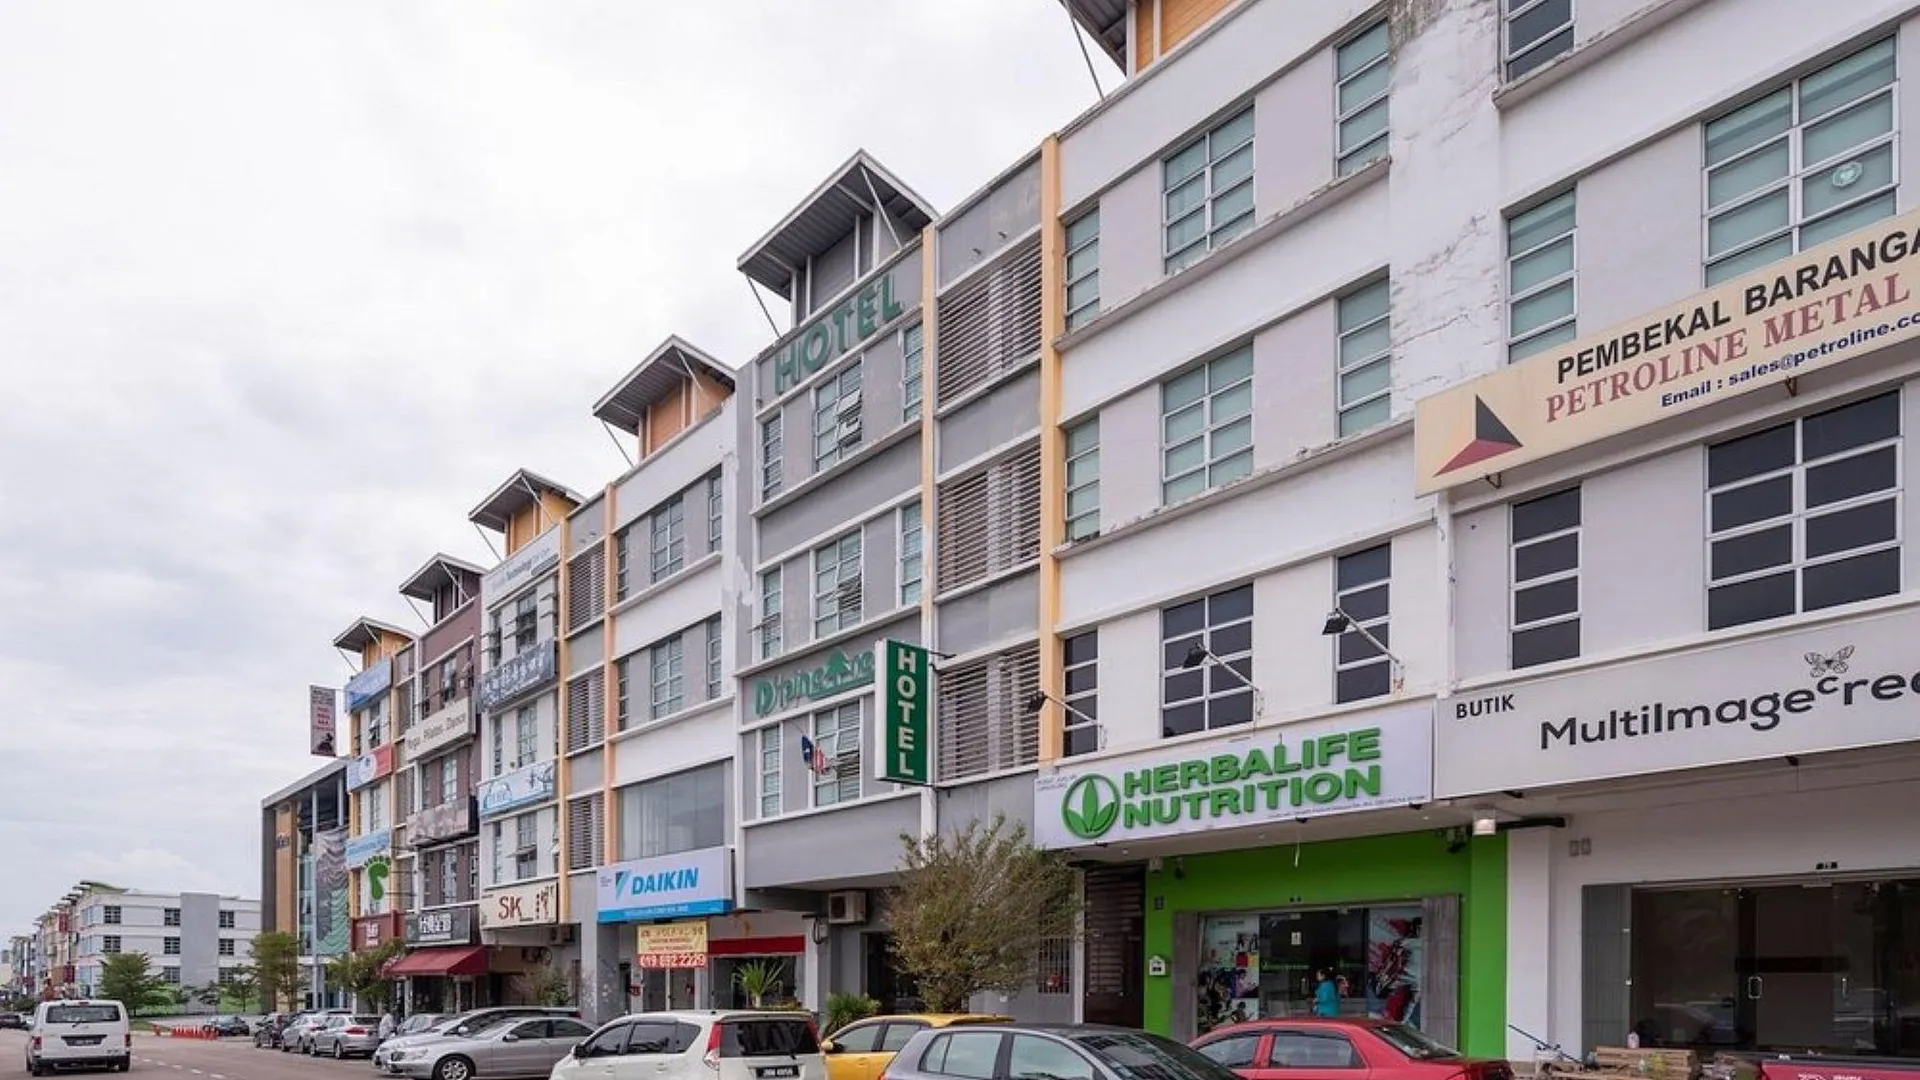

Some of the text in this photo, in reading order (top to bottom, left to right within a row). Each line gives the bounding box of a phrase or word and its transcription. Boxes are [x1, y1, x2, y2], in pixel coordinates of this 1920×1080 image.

[774, 272, 902, 395] HOTEL
[1546, 273, 1911, 422] PETROLINE METAL
[1557, 300, 1731, 384] PEMBEKAL
[1661, 379, 1711, 408] Email
[897, 648, 917, 776] HOTEL
[1456, 694, 1515, 719] BUTIK
[1124, 727, 1381, 799] HERBALIFE
[1124, 764, 1381, 829] NUTRITION
[632, 867, 699, 895] DAIKIN
